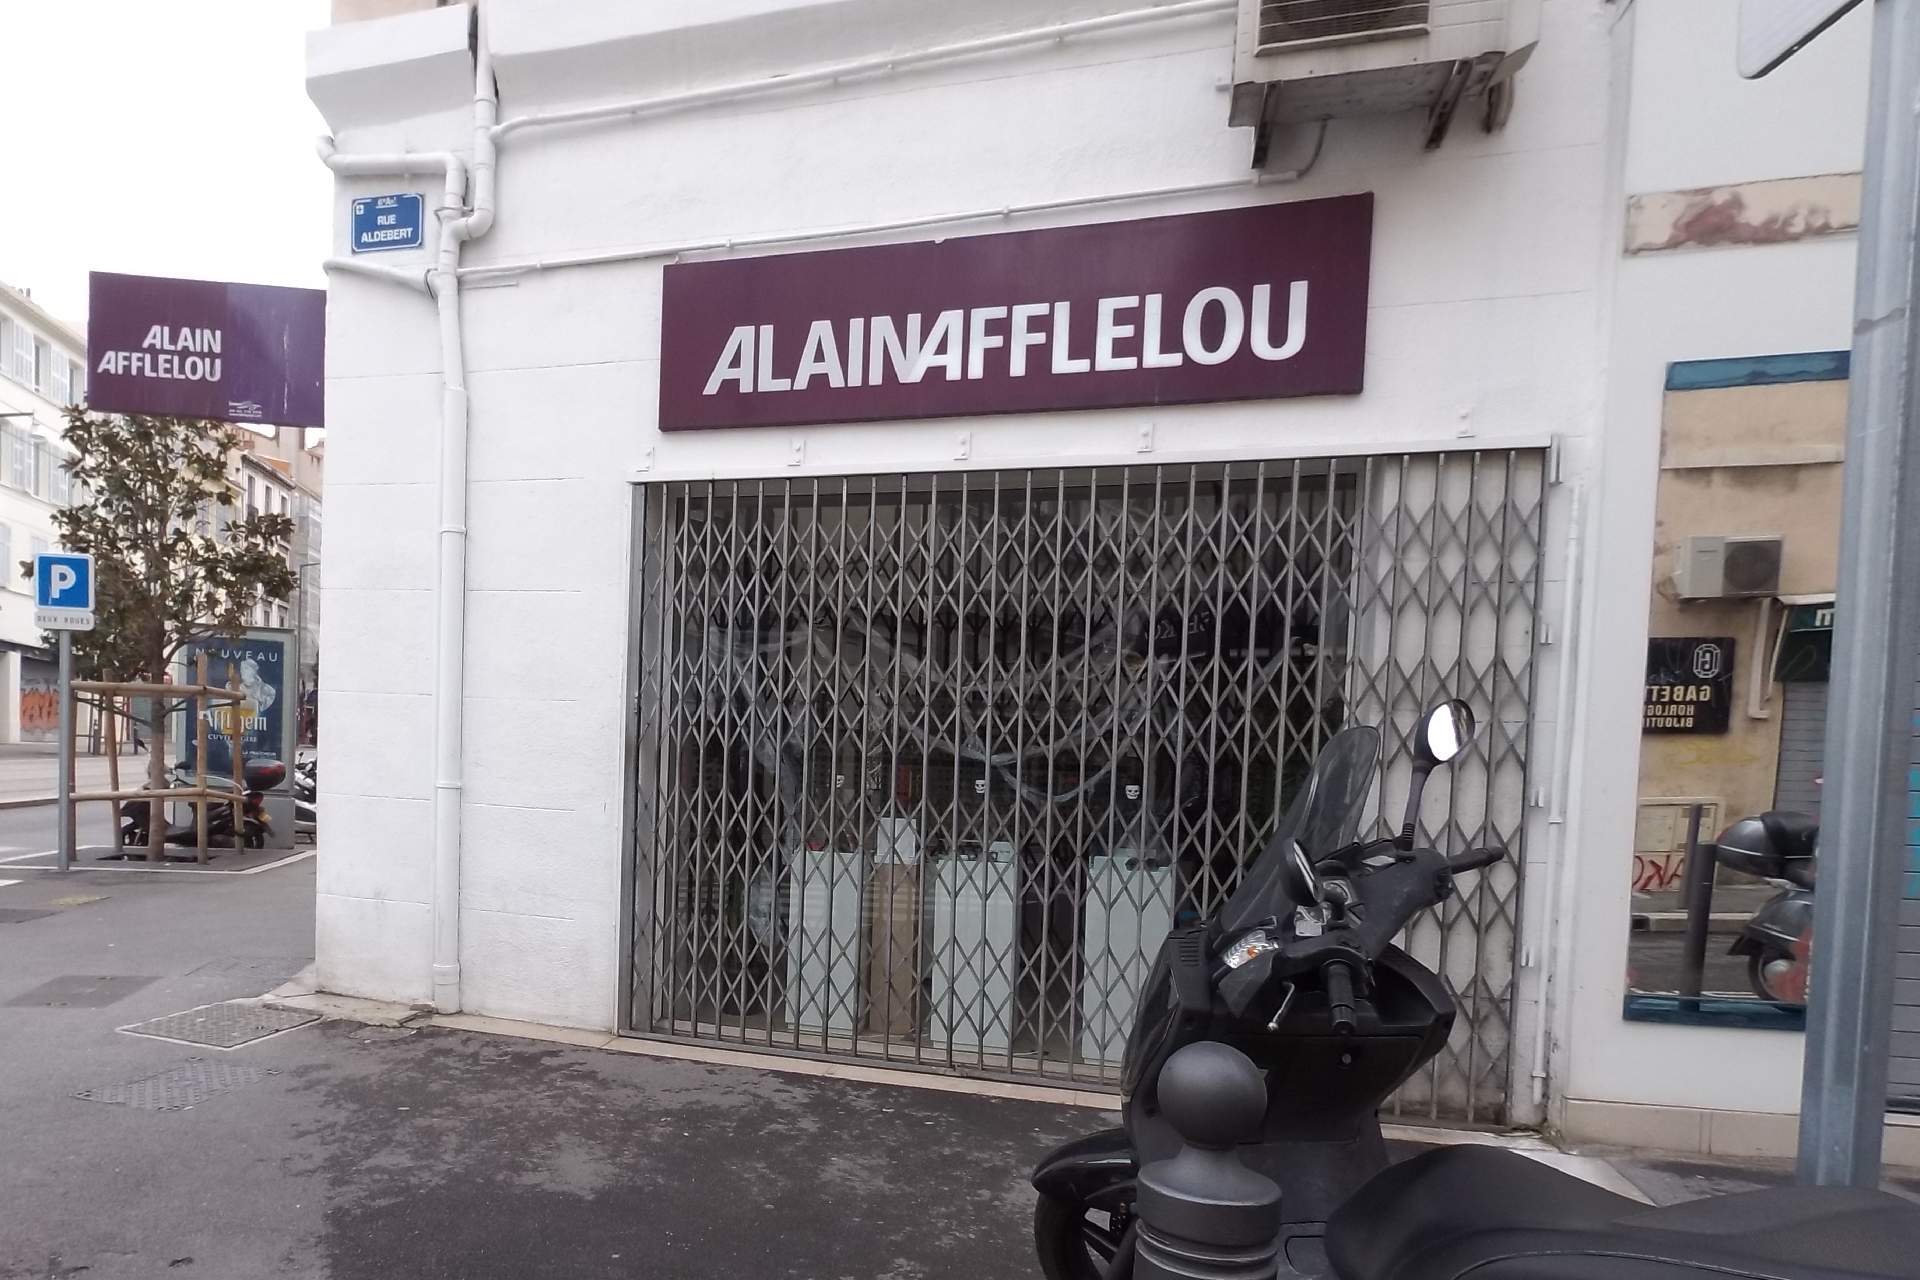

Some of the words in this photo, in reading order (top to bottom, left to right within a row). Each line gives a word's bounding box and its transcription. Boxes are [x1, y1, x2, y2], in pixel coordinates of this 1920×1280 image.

[377, 214, 397, 226] RUE
[361, 227, 413, 243] ALDEBERT
[142, 325, 222, 353] ALAIN
[96, 351, 222, 382] AFFLELOU
[51, 564, 77, 599] P
[195, 648, 278, 662] NUVEAU
